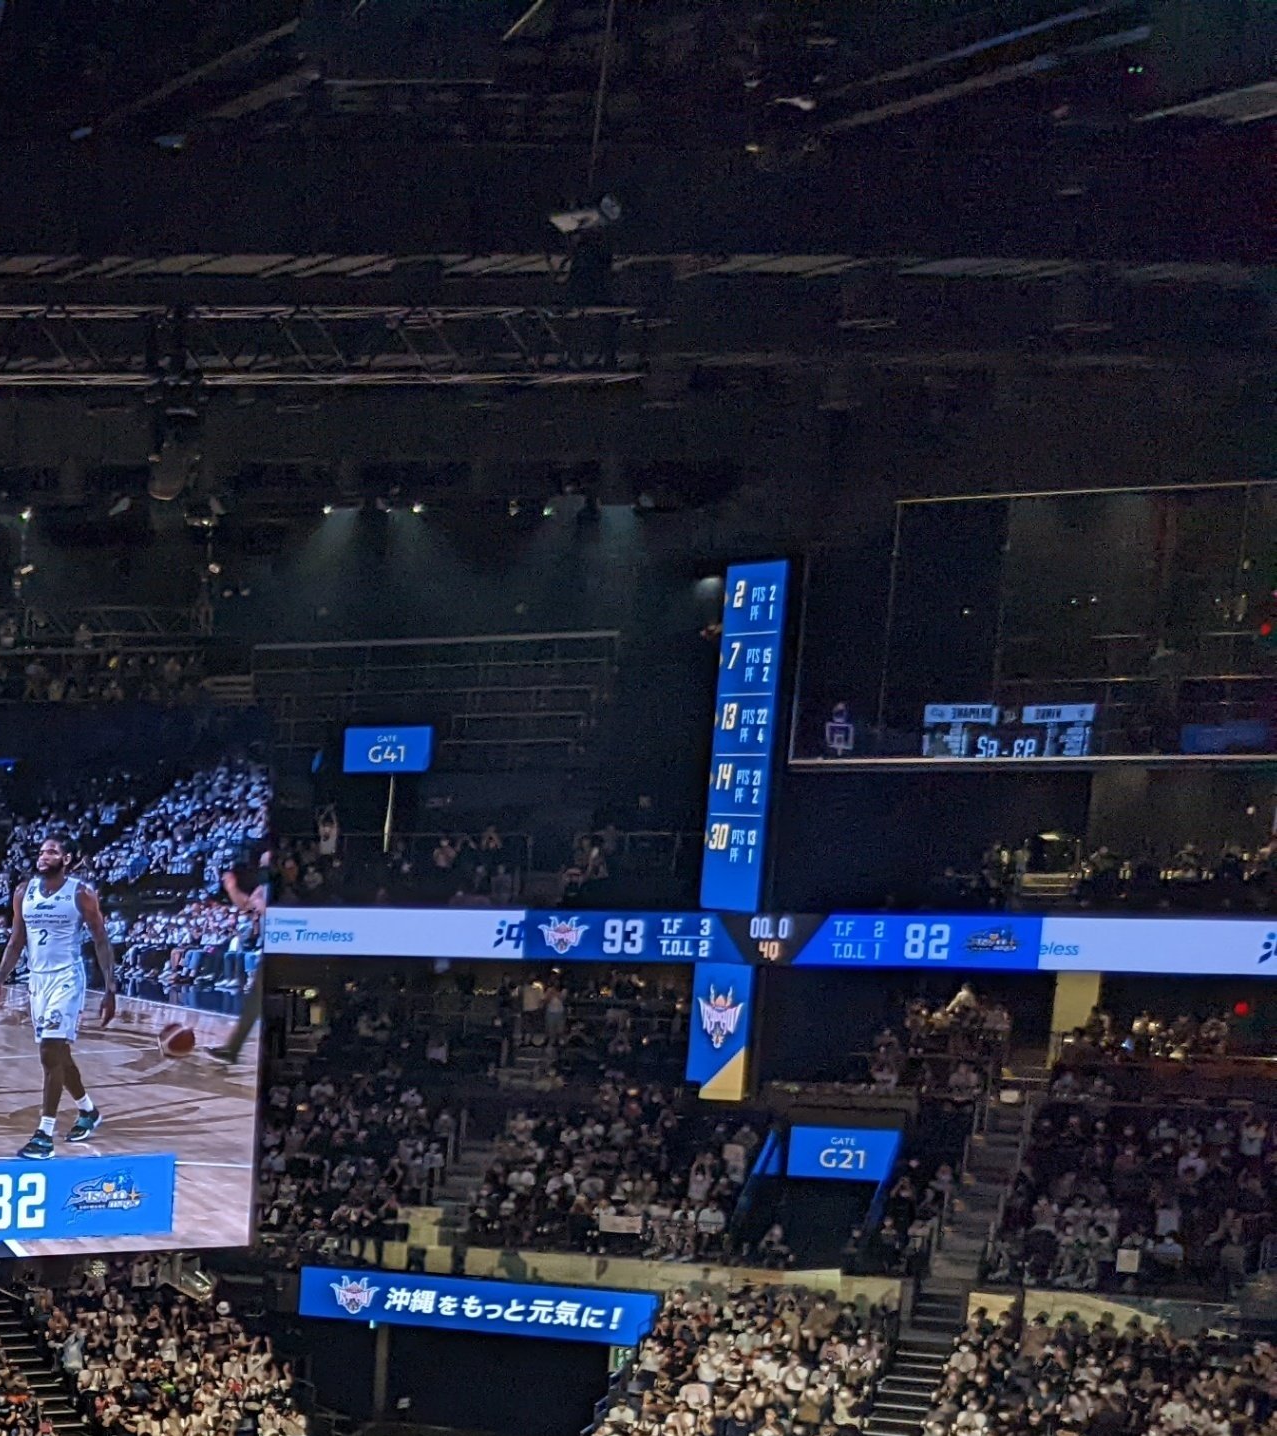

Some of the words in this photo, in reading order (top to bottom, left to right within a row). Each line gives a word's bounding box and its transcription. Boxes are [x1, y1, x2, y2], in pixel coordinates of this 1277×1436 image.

[733, 580, 746, 608] 2
[752, 587, 766, 602] PTS
[769, 585, 776, 601] 2
[750, 605, 759, 621] PF
[768, 604, 774, 620] 1
[727, 642, 741, 670] 7
[746, 648, 761, 664] PTS
[763, 648, 772, 664] 15
[744, 667, 753, 683] PF
[762, 666, 770, 682] 2
[721, 703, 737, 730] 13
[741, 709, 755, 725] PTS
[756, 709, 768, 725] 22
[377, 735, 397, 743] GATE
[739, 728, 748, 743] PF
[757, 728, 764, 743] 4
[368, 745, 405, 763] G41
[715, 763, 733, 790] 14
[736, 770, 750, 786] PTS
[752, 770, 761, 786] 21
[734, 788, 744, 803] PF
[751, 788, 759, 804] 2
[708, 824, 729, 850] 30
[731, 830, 745, 846] PTS
[747, 830, 757, 846] 13
[729, 848, 739, 863] PF
[748, 848, 753, 863] 1
[661, 918, 682, 935] T.F
[700, 918, 711, 936] 3
[833, 920, 855, 938] T.F
[874, 920, 884, 939] 2
[38, 929, 48, 946] 2
[296, 929, 354, 943] Timeless
[603, 919, 644, 954] 93
[904, 923, 951, 960] 82
[660, 940, 692, 956] T.O.L
[699, 940, 710, 957] 2
[758, 941, 779, 960] 4Q
[831, 943, 866, 960] T.O.L
[874, 943, 880, 960] 1
[830, 1137, 856, 1146] GATE
[819, 1148, 865, 1170] G21
